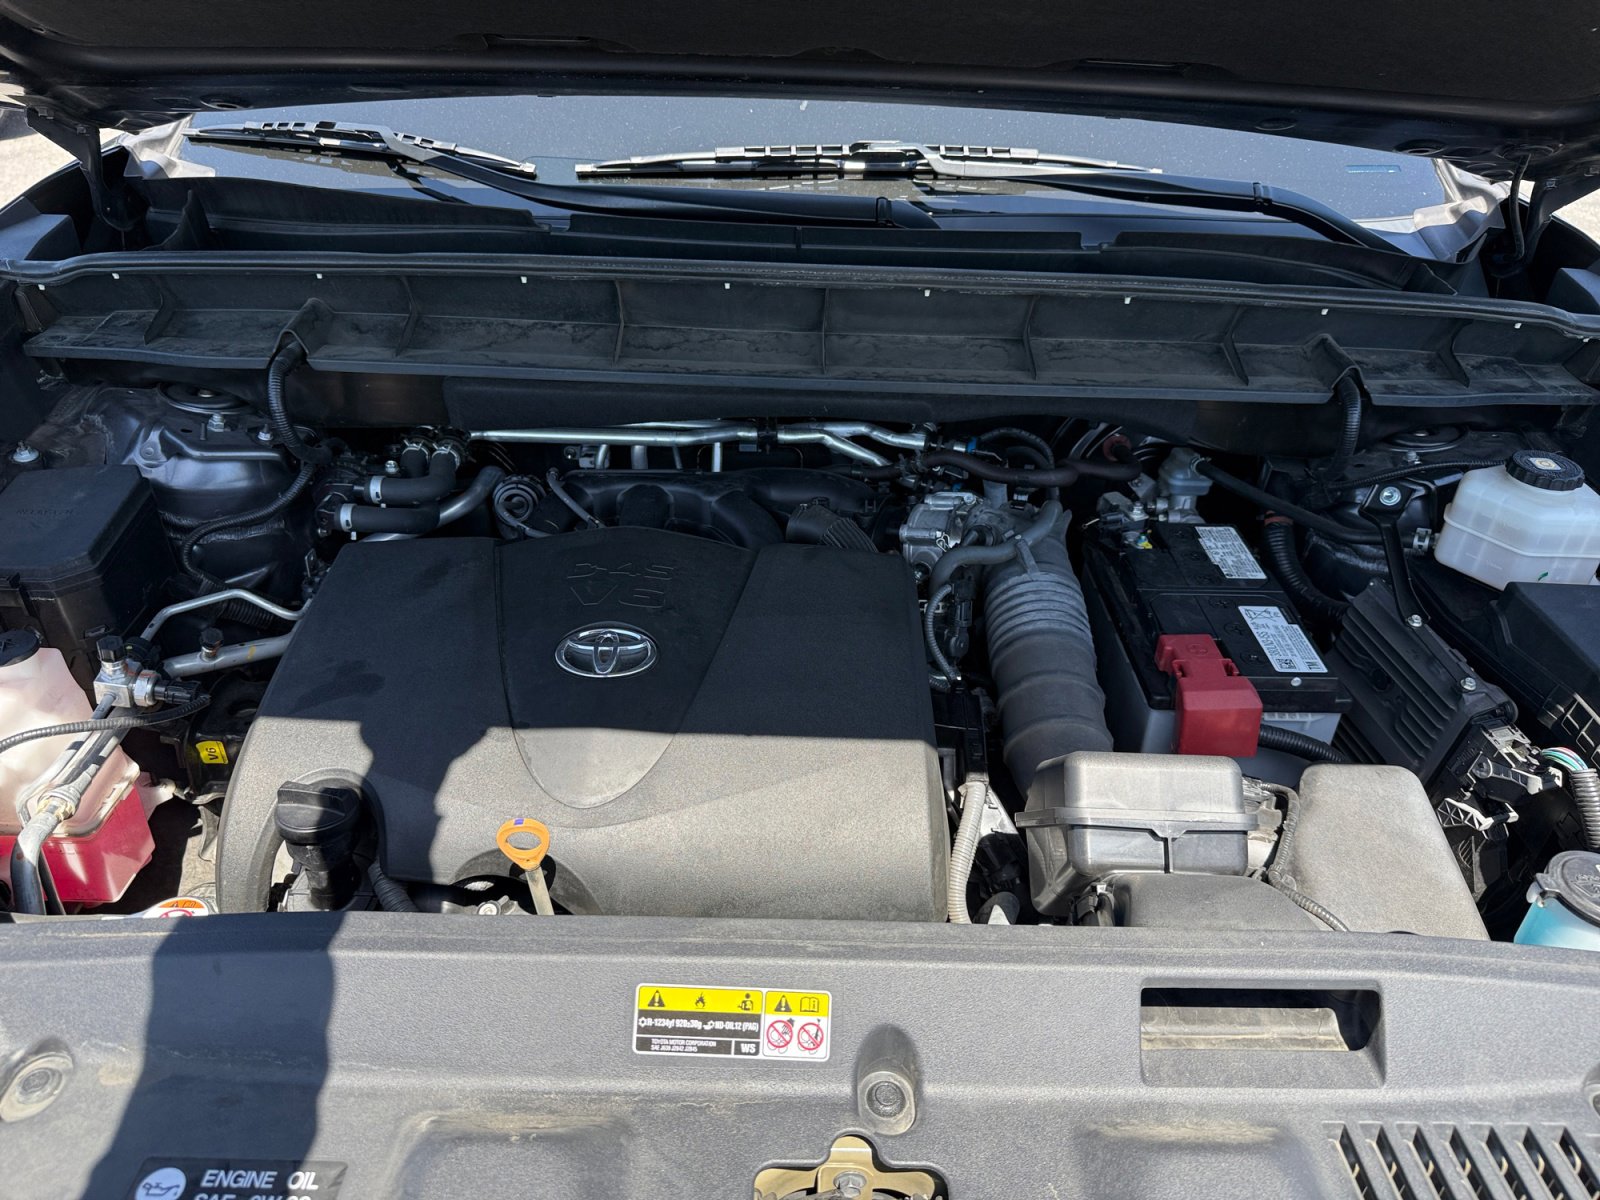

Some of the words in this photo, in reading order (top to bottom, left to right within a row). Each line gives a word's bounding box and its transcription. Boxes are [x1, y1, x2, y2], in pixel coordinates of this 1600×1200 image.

[646, 1017, 675, 1029] R-1234yf
[740, 1043, 756, 1053] WS
[201, 1169, 278, 1189] ENGINE
[287, 1171, 319, 1191] OIL
